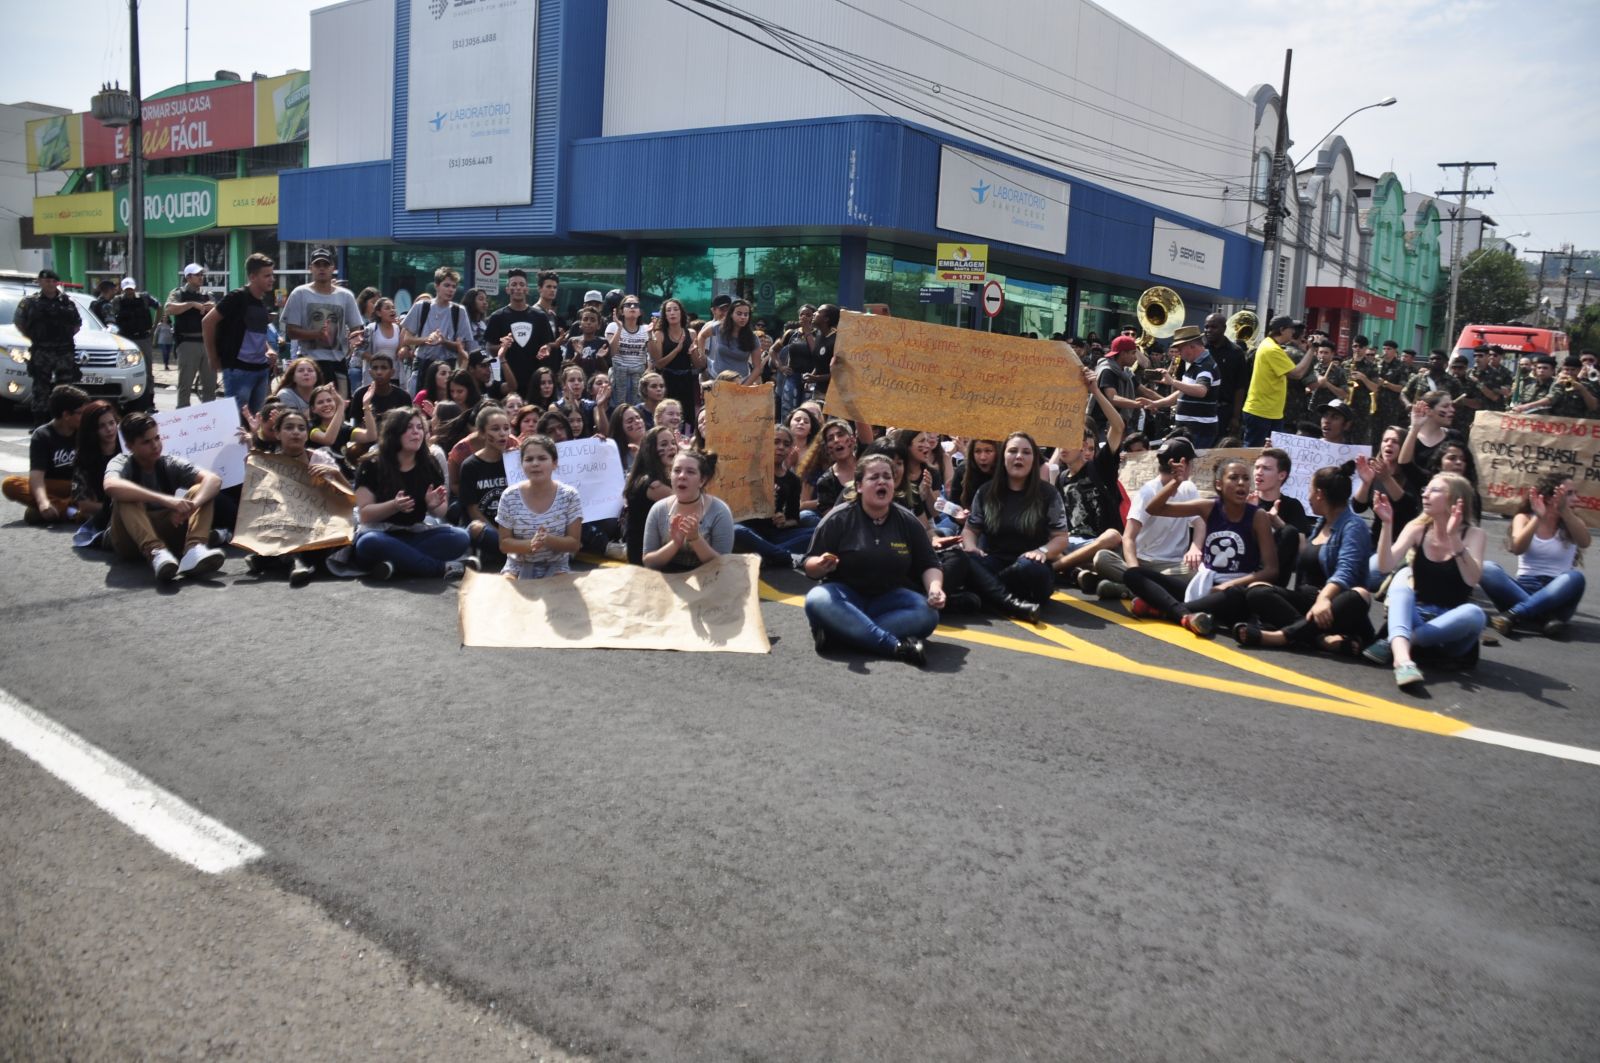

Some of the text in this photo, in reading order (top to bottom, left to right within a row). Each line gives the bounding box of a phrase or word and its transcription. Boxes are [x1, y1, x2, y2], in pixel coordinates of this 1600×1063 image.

[171, 99, 187, 116] SUA
[188, 96, 212, 113] CASA
[115, 126, 124, 159] É
[171, 117, 213, 152] FÁCIL
[484, 258, 491, 271] E
[938, 260, 985, 268] EMBALAGEM
[1482, 440, 1517, 458] ONDE
[1521, 445, 1532, 460] O
[1536, 446, 1583, 466] BRASIL
